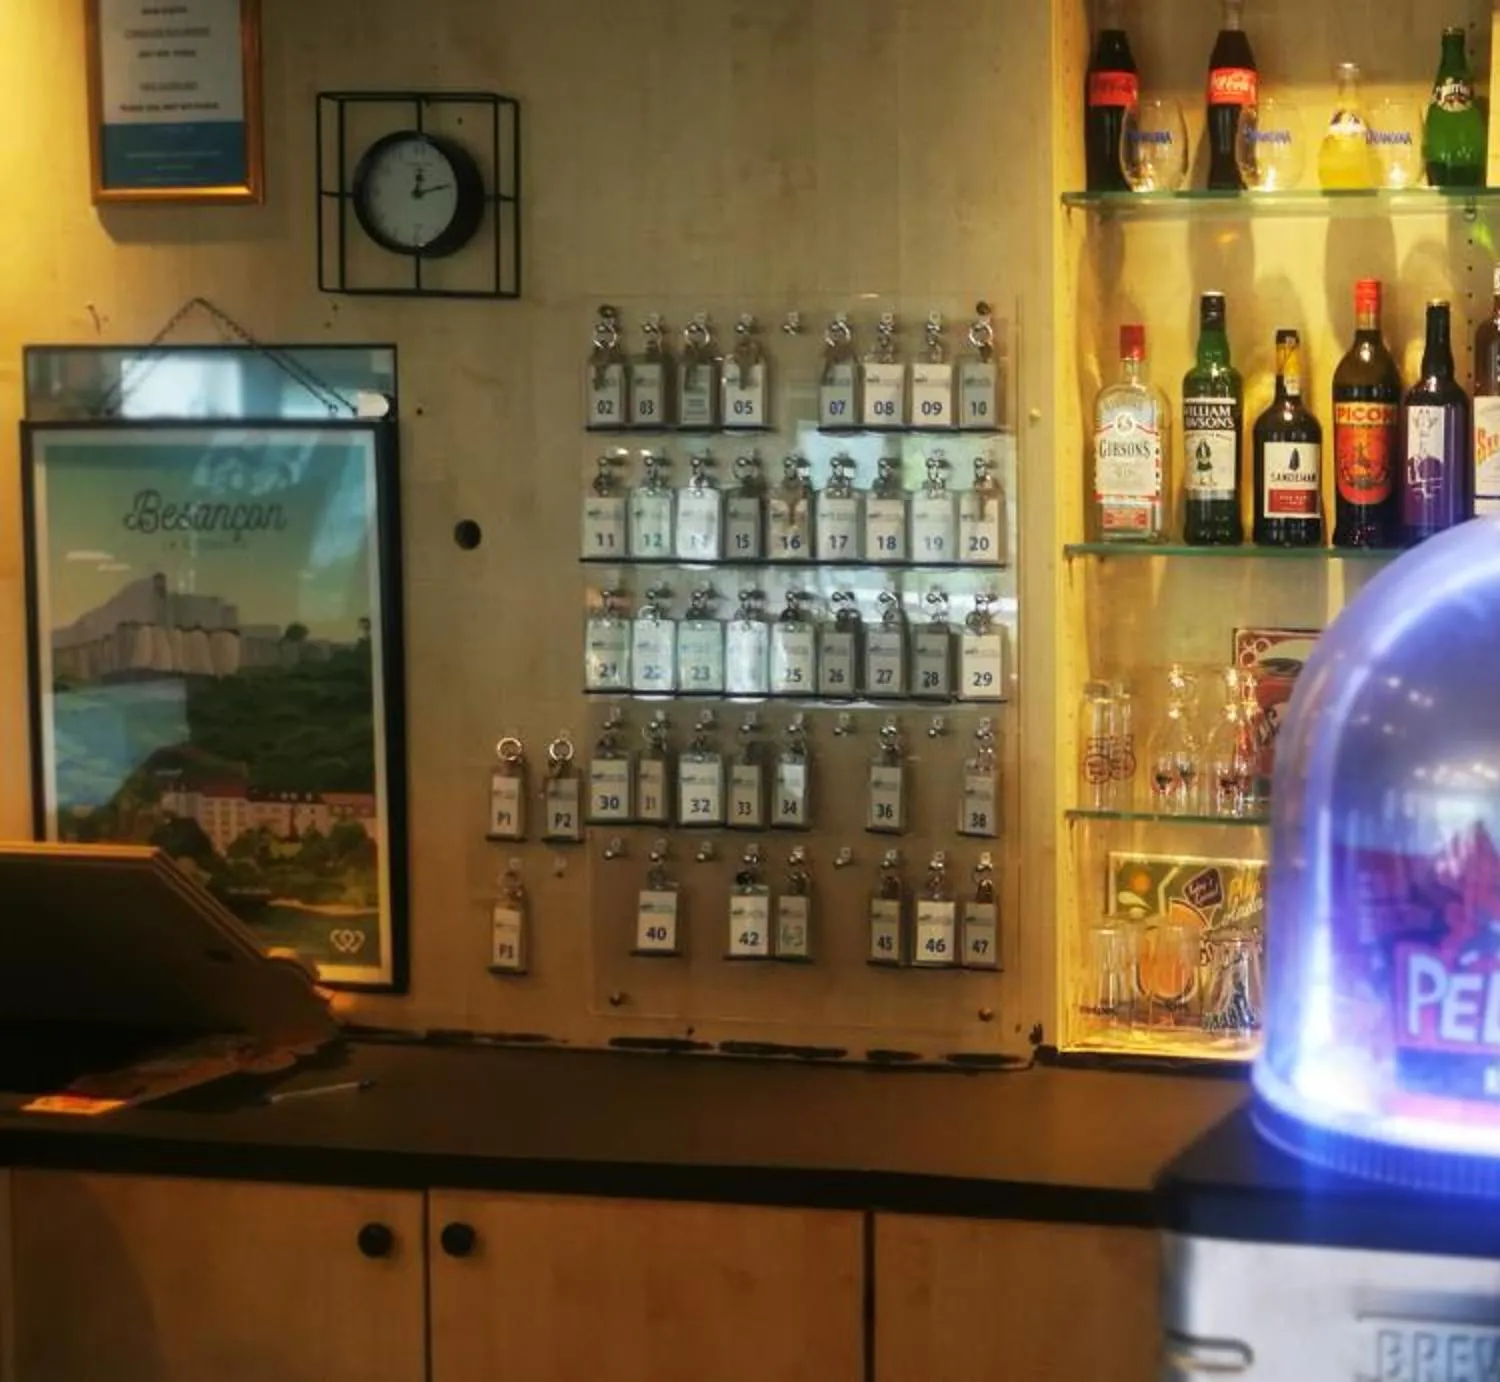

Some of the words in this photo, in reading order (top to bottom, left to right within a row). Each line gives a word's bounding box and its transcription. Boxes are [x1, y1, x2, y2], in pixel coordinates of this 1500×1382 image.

[597, 401, 614, 415] 02
[639, 401, 654, 415] 03
[734, 401, 753, 415] 05
[830, 401, 845, 415] 07
[874, 401, 894, 415] 08
[922, 402, 942, 415] 09
[972, 402, 987, 416] 10
[122, 489, 289, 543] Besançon
[597, 532, 614, 547] 11
[643, 533, 662, 547] 12
[736, 534, 750, 548] 15
[782, 536, 801, 550] 16
[829, 535, 849, 550] 17
[877, 536, 897, 551] 18
[924, 536, 943, 551] 19
[969, 536, 990, 551] 20
[829, 669, 844, 684] 26
[877, 669, 893, 684] 27
[923, 671, 939, 687] 28
[973, 671, 993, 687] 29
[600, 796, 619, 811] 30
[691, 799, 711, 814] 32
[738, 801, 751, 816] 33
[781, 799, 797, 815] 34
[877, 804, 893, 819] 36
[497, 812, 512, 828] P1
[554, 812, 572, 829] P2
[971, 812, 987, 828] 38
[646, 926, 667, 942] 40
[738, 930, 759, 946] 42
[876, 936, 893, 951] 45
[925, 937, 946, 953] 46
[972, 939, 989, 954] 47
